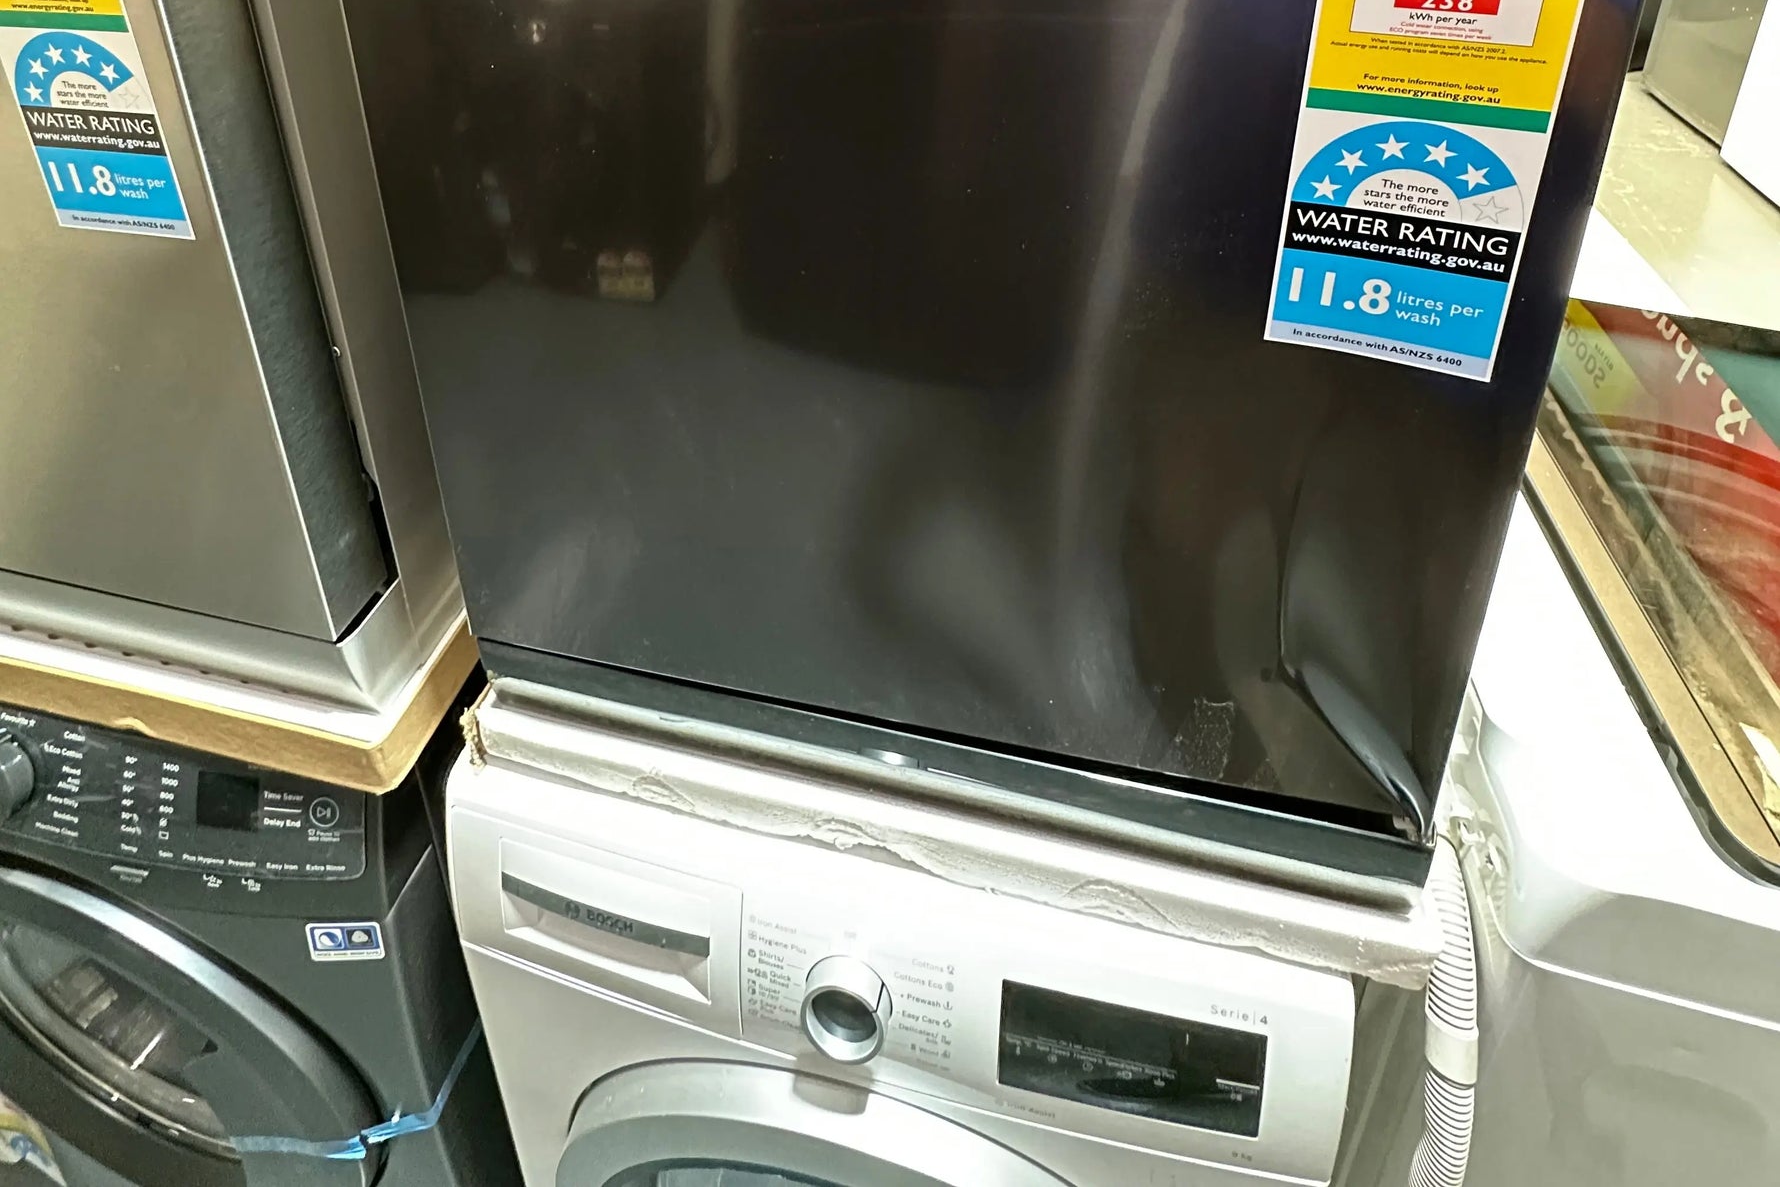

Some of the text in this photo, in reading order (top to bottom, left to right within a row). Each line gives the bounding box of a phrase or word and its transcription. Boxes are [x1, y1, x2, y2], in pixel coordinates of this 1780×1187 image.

[1409, 11, 1477, 26] kWh per year
[62, 80, 97, 91] The more
[1363, 72, 1500, 95] For more information, look up
[57, 90, 107, 100] stars the more
[1356, 82, 1501, 105] www.energyrating.gov.au
[59, 99, 80, 107] water
[27, 110, 155, 135] WATER RATING
[34, 130, 160, 150] www.waterrating.gov.au
[48, 161, 117, 196] 11.8
[115, 172, 166, 190] litres per
[1381, 178, 1439, 195] The more
[119, 188, 149, 200] wash
[1364, 187, 1449, 208] stars the more
[1363, 198, 1446, 218] water efficient
[1296, 207, 1509, 256] WATER RATING
[1292, 230, 1505, 274] www.waterrating.gov.au
[1288, 267, 1393, 315] 11.8
[1397, 290, 1484, 320] litres per
[1395, 308, 1441, 327] wash
[1292, 327, 1463, 367] In accordance with AS/NZS 6400
[163, 762, 180, 773] 1400
[161, 776, 179, 788] 1000
[264, 790, 282, 800] Time
[263, 817, 301, 828] Delay End
[266, 862, 284, 871] Easy
[305, 864, 325, 872] Extra
[586, 908, 634, 933] BOSCH
[769, 970, 791, 982] Quick
[906, 992, 942, 1009] Prewash
[901, 1009, 941, 1027] Easy Care
[1210, 1004, 1269, 1025] Serie 4
